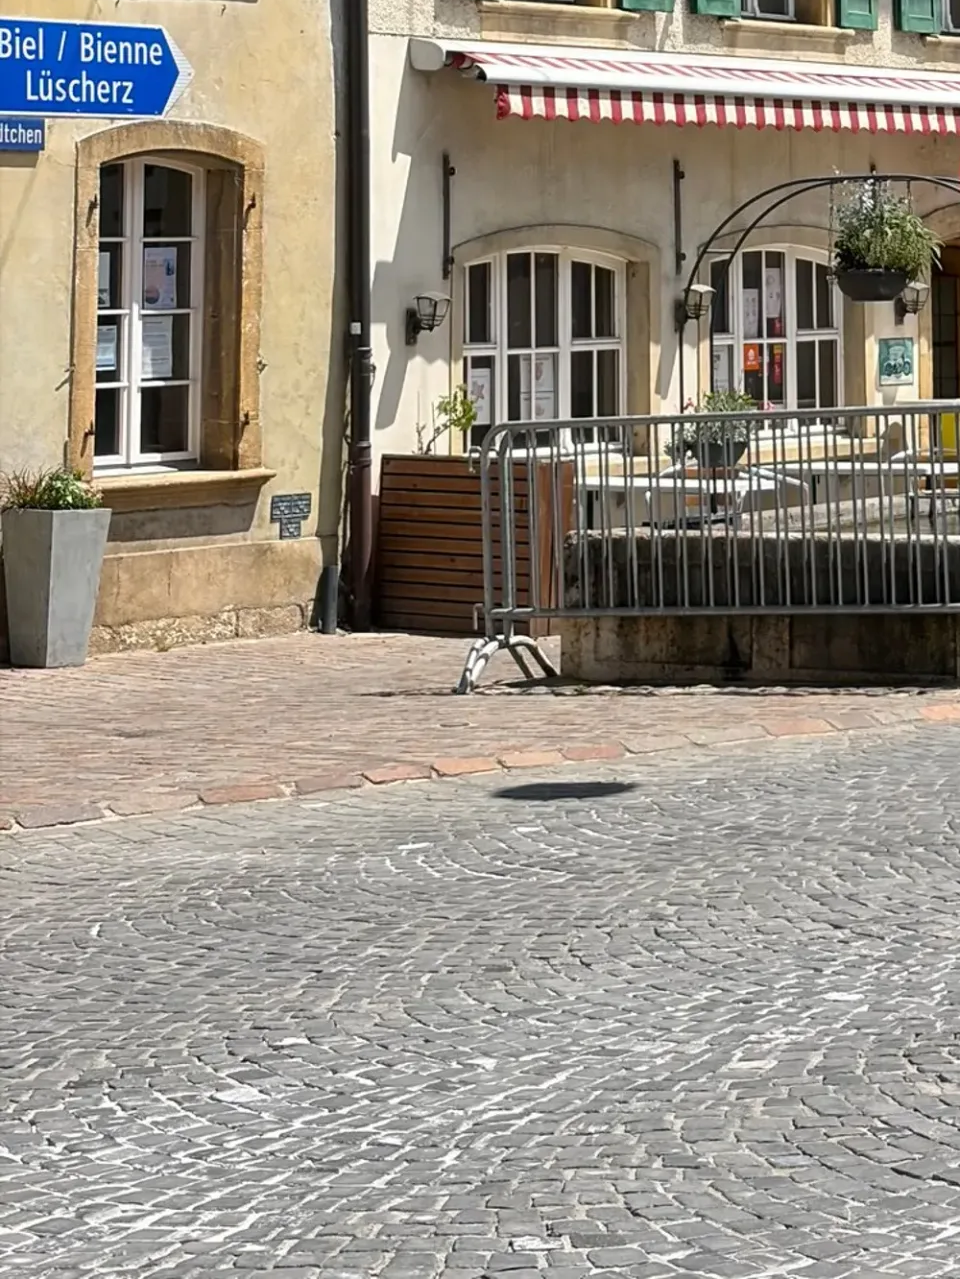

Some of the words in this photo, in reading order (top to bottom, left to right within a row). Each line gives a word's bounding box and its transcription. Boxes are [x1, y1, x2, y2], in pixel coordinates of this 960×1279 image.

[0, 27, 44, 61] Biel
[57, 30, 68, 62] /
[80, 32, 163, 65] Bienne
[26, 69, 134, 104] Lüscherz
